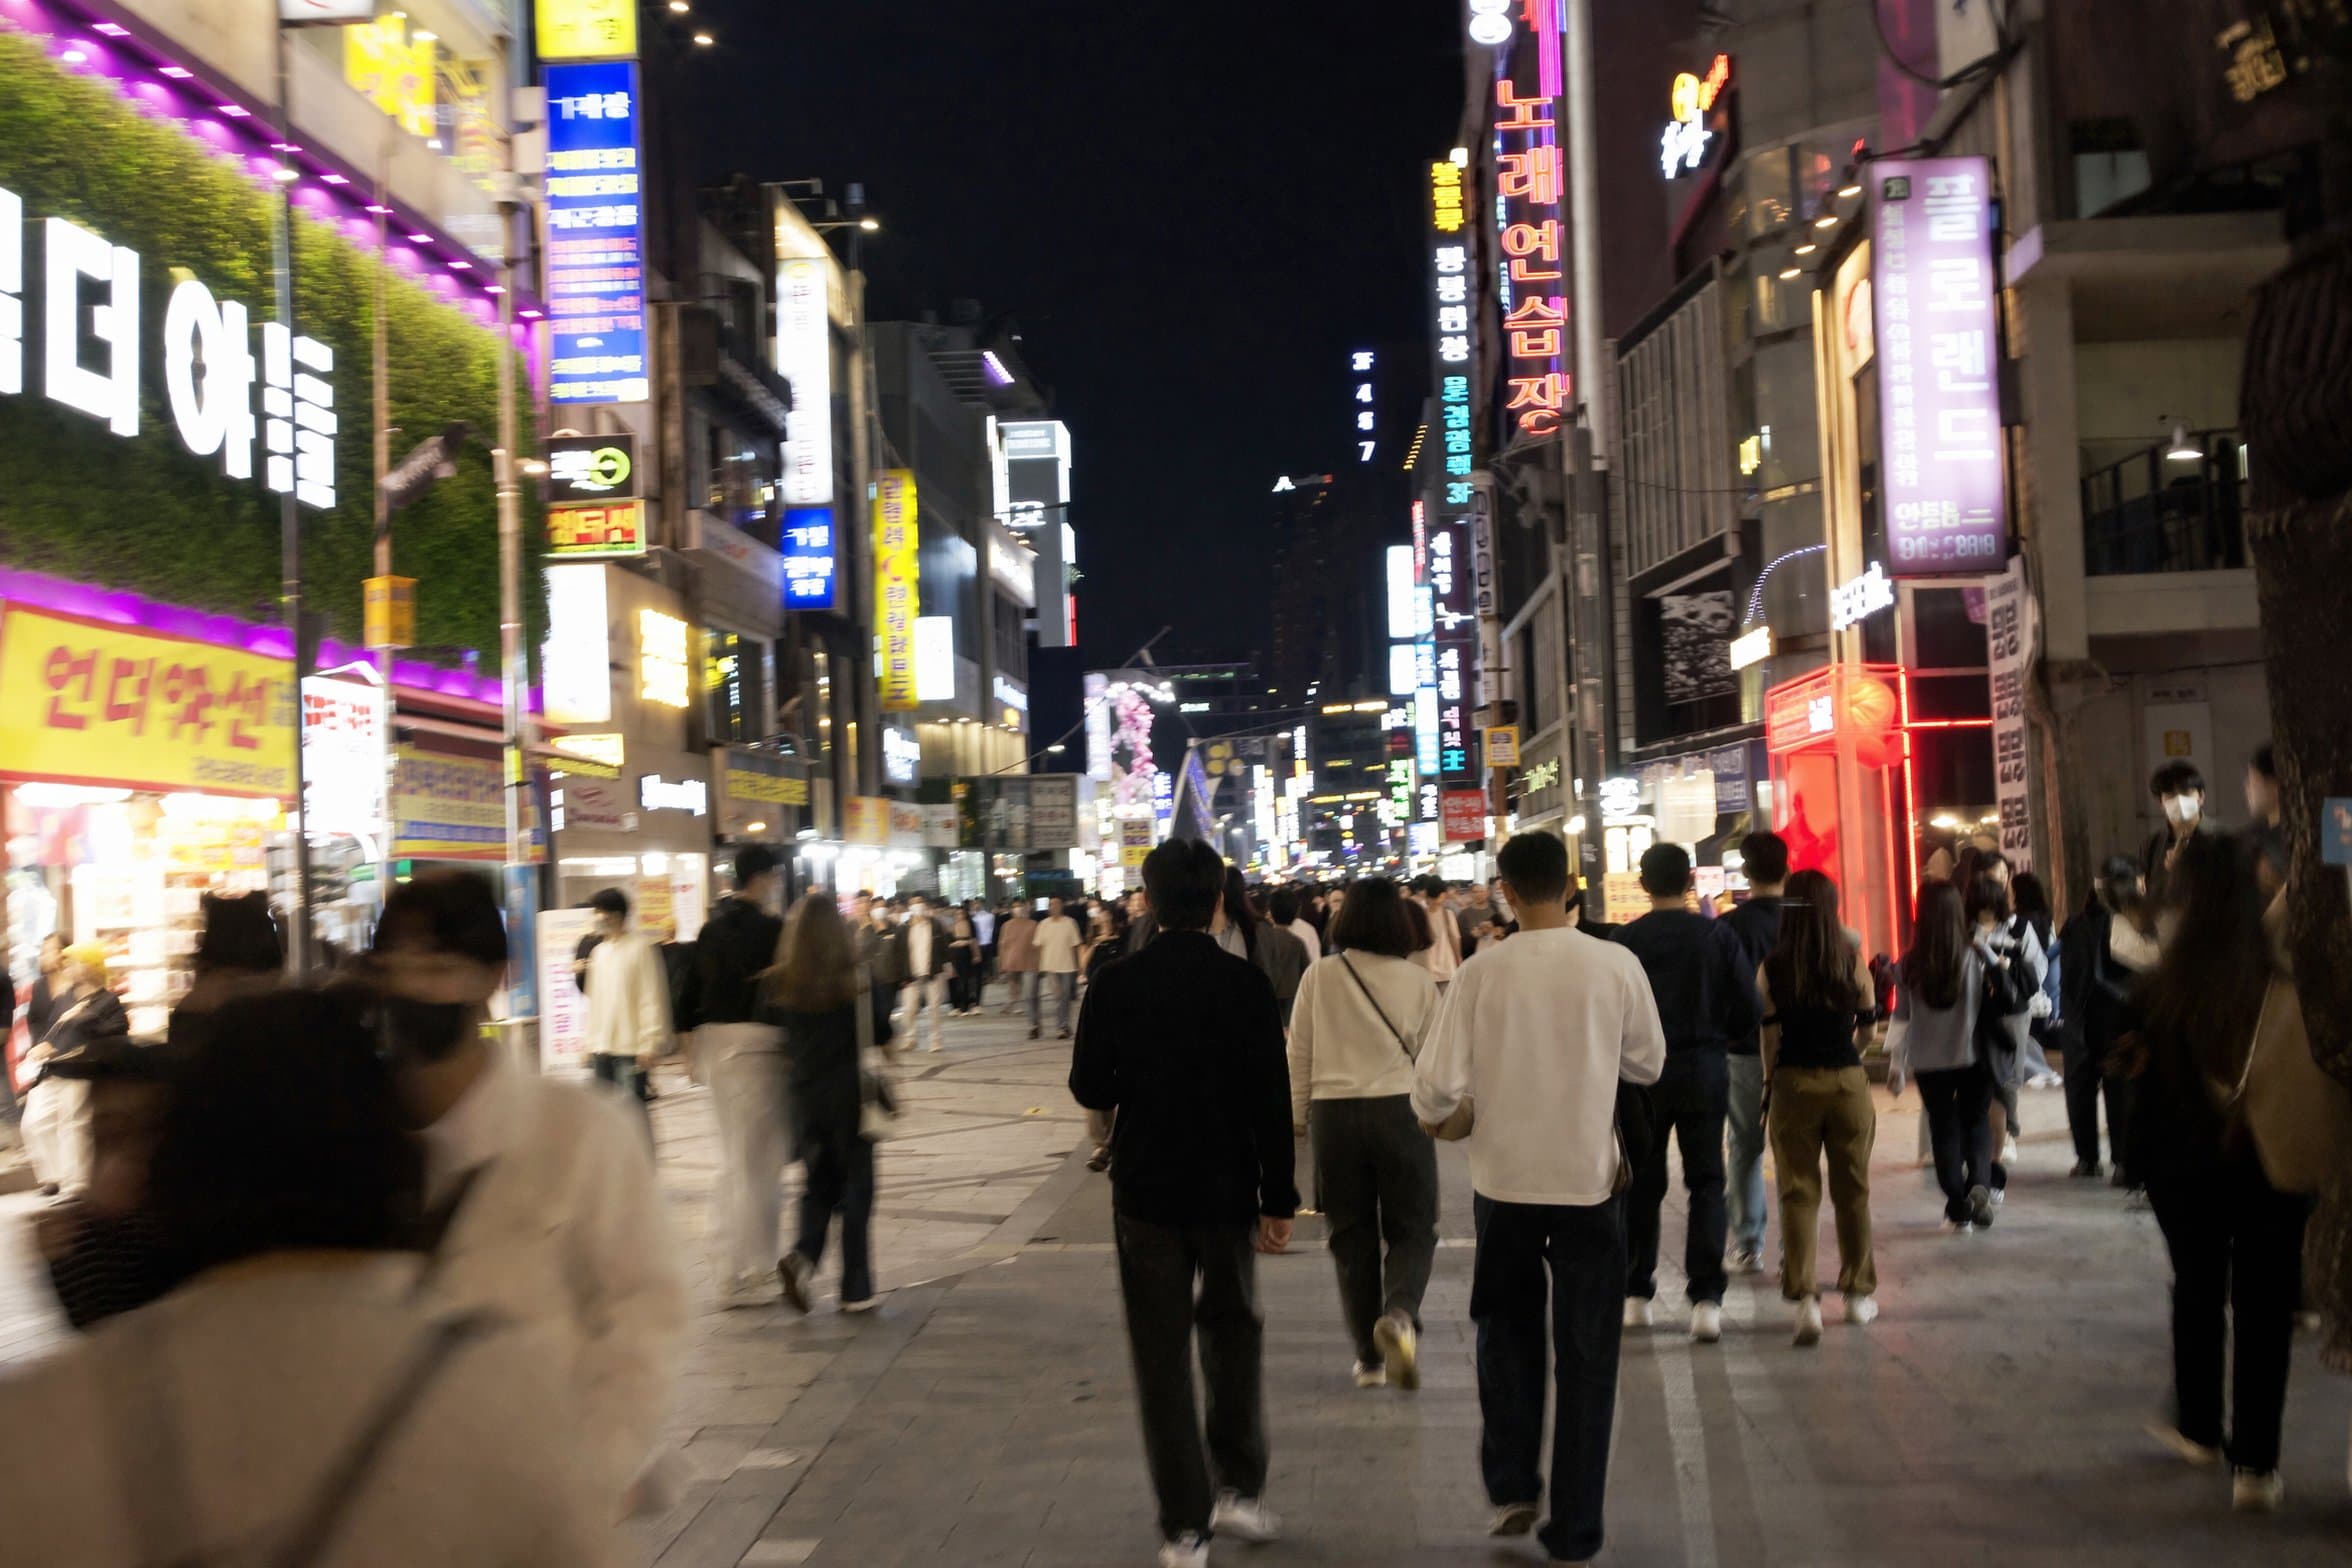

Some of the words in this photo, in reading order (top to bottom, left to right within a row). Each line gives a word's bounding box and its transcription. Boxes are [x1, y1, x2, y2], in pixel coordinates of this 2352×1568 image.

[0, 187, 338, 510] 더야들
[1495, 80, 1570, 434] 노래연습장
[1358, 440, 1376, 462] 7
